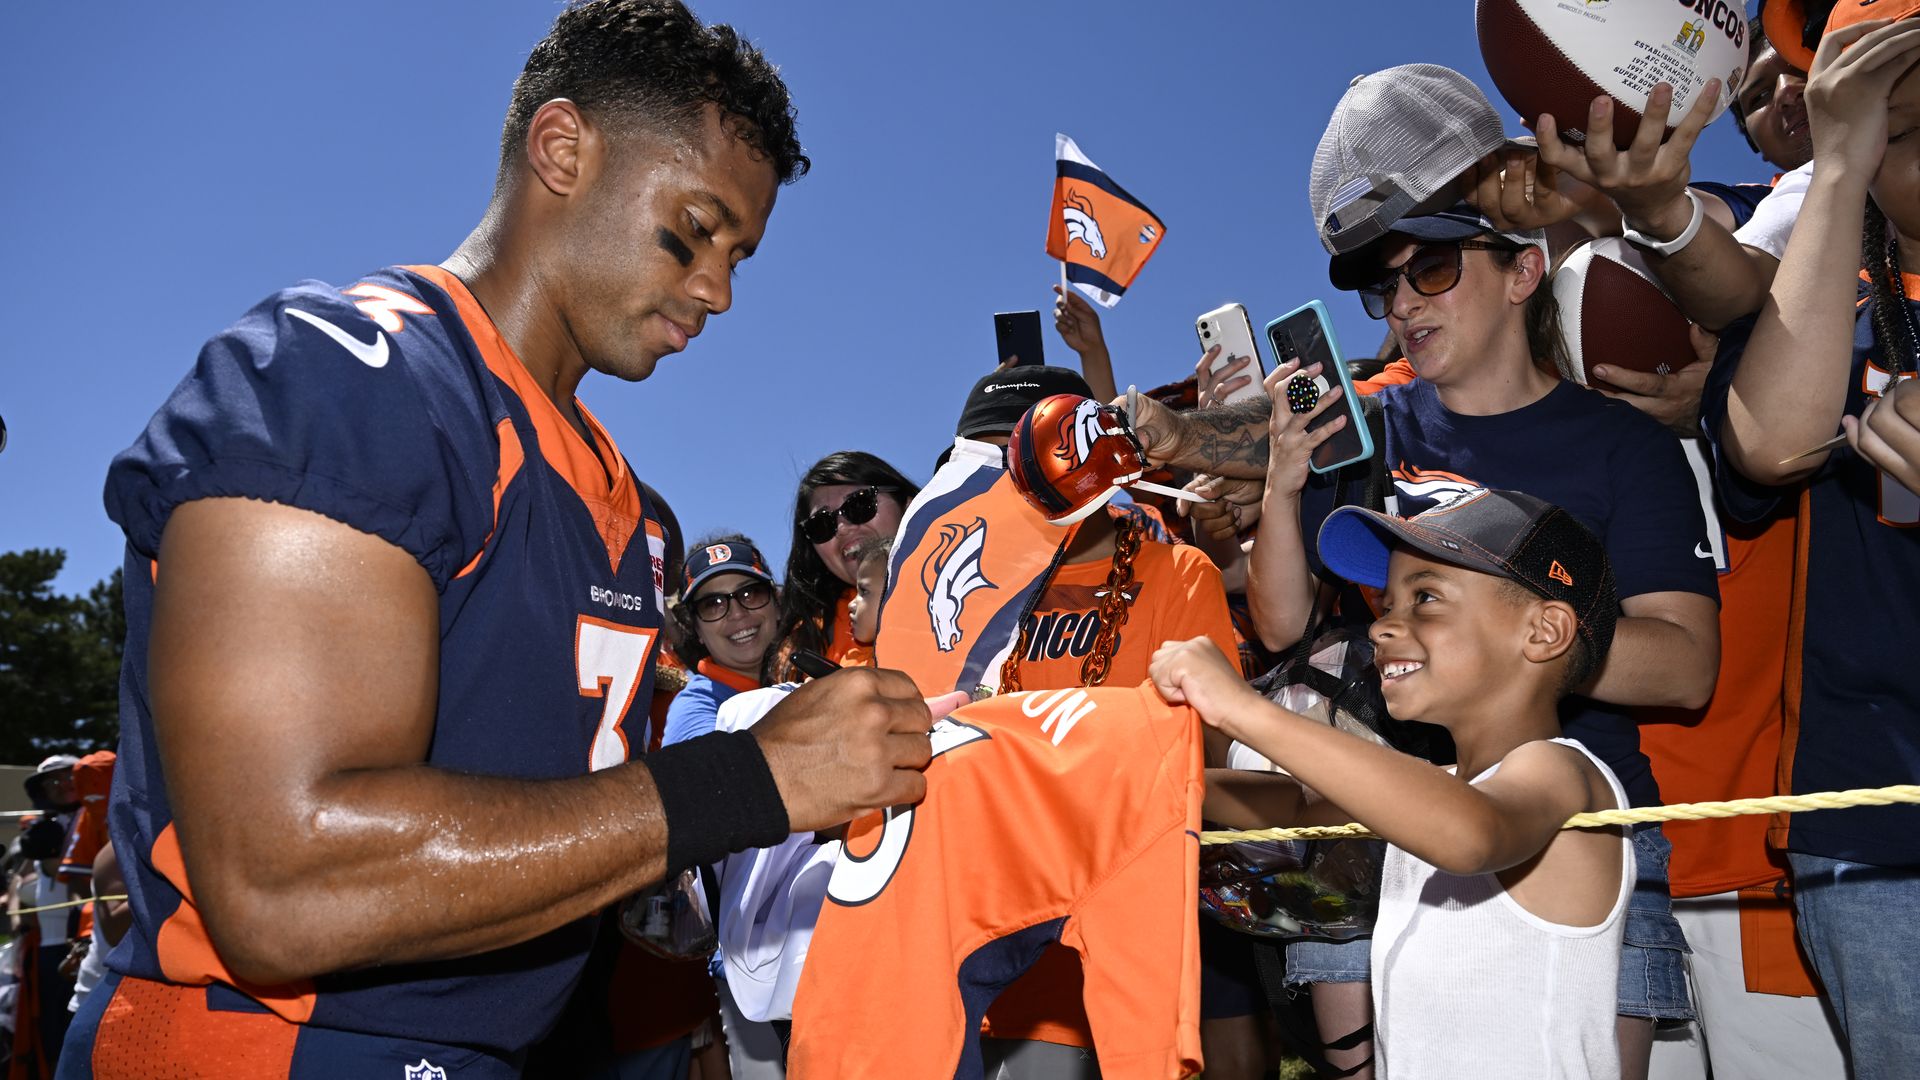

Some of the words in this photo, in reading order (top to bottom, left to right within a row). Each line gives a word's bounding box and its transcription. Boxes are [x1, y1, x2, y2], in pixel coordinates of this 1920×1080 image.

[1678, 0, 1745, 49] NCOS
[1632, 57, 1648, 69] 1977,
[1634, 40, 1680, 67] ESTABLISHED
[1613, 66, 1638, 81] SUPER
[1637, 77, 1654, 89] BOW
[1645, 54, 1660, 65] AFC
[1659, 62, 1692, 86] CHAMPIONS
[984, 381, 1040, 393] Champion
[705, 544, 732, 566] D
[590, 585, 642, 611] BRONCOS
[1025, 608, 1121, 662] NCO
